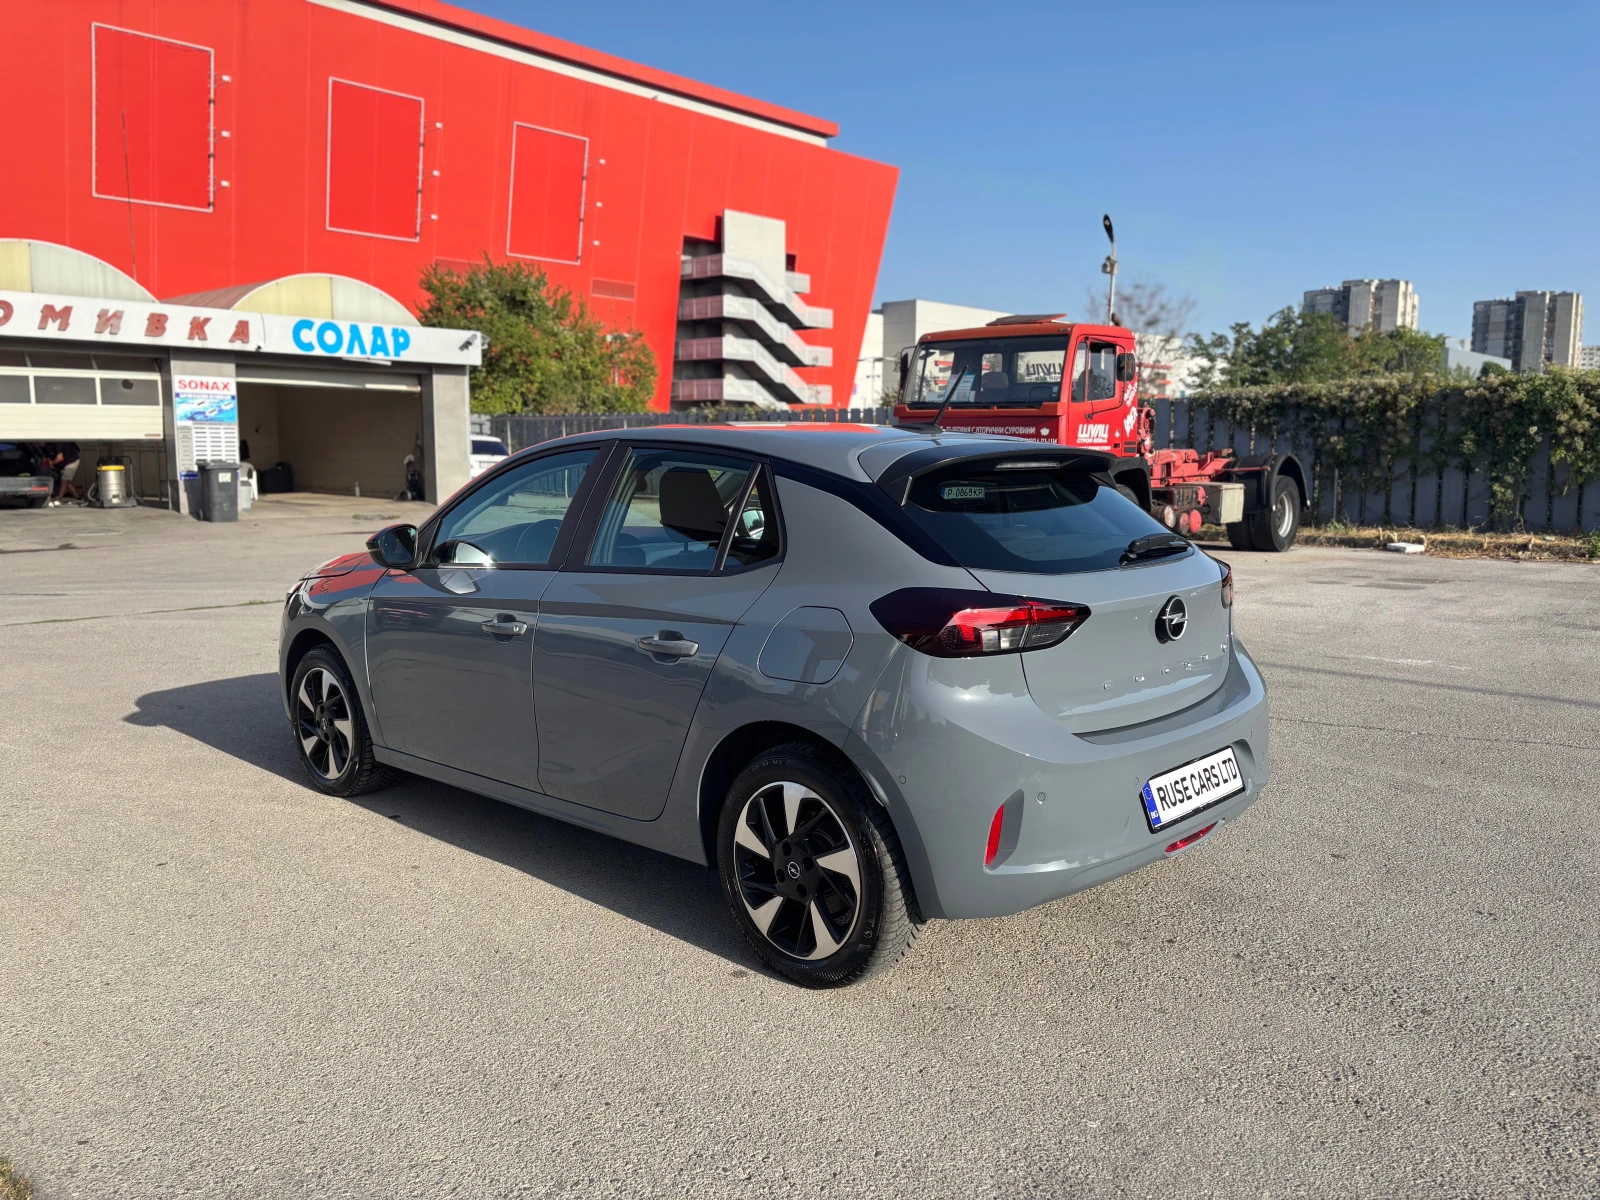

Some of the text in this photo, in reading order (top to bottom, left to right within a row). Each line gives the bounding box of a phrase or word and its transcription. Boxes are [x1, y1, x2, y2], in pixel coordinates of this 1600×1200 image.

[292, 319, 411, 357] СОЛАР
[178, 379, 230, 391] SONAX
[1004, 426, 1036, 434] СУРОВИНИ
[1077, 424, 1110, 440] ШУЛЦ
[1156, 757, 1238, 811] RUSE CARS LTD
[1150, 810, 1159, 819] BG
